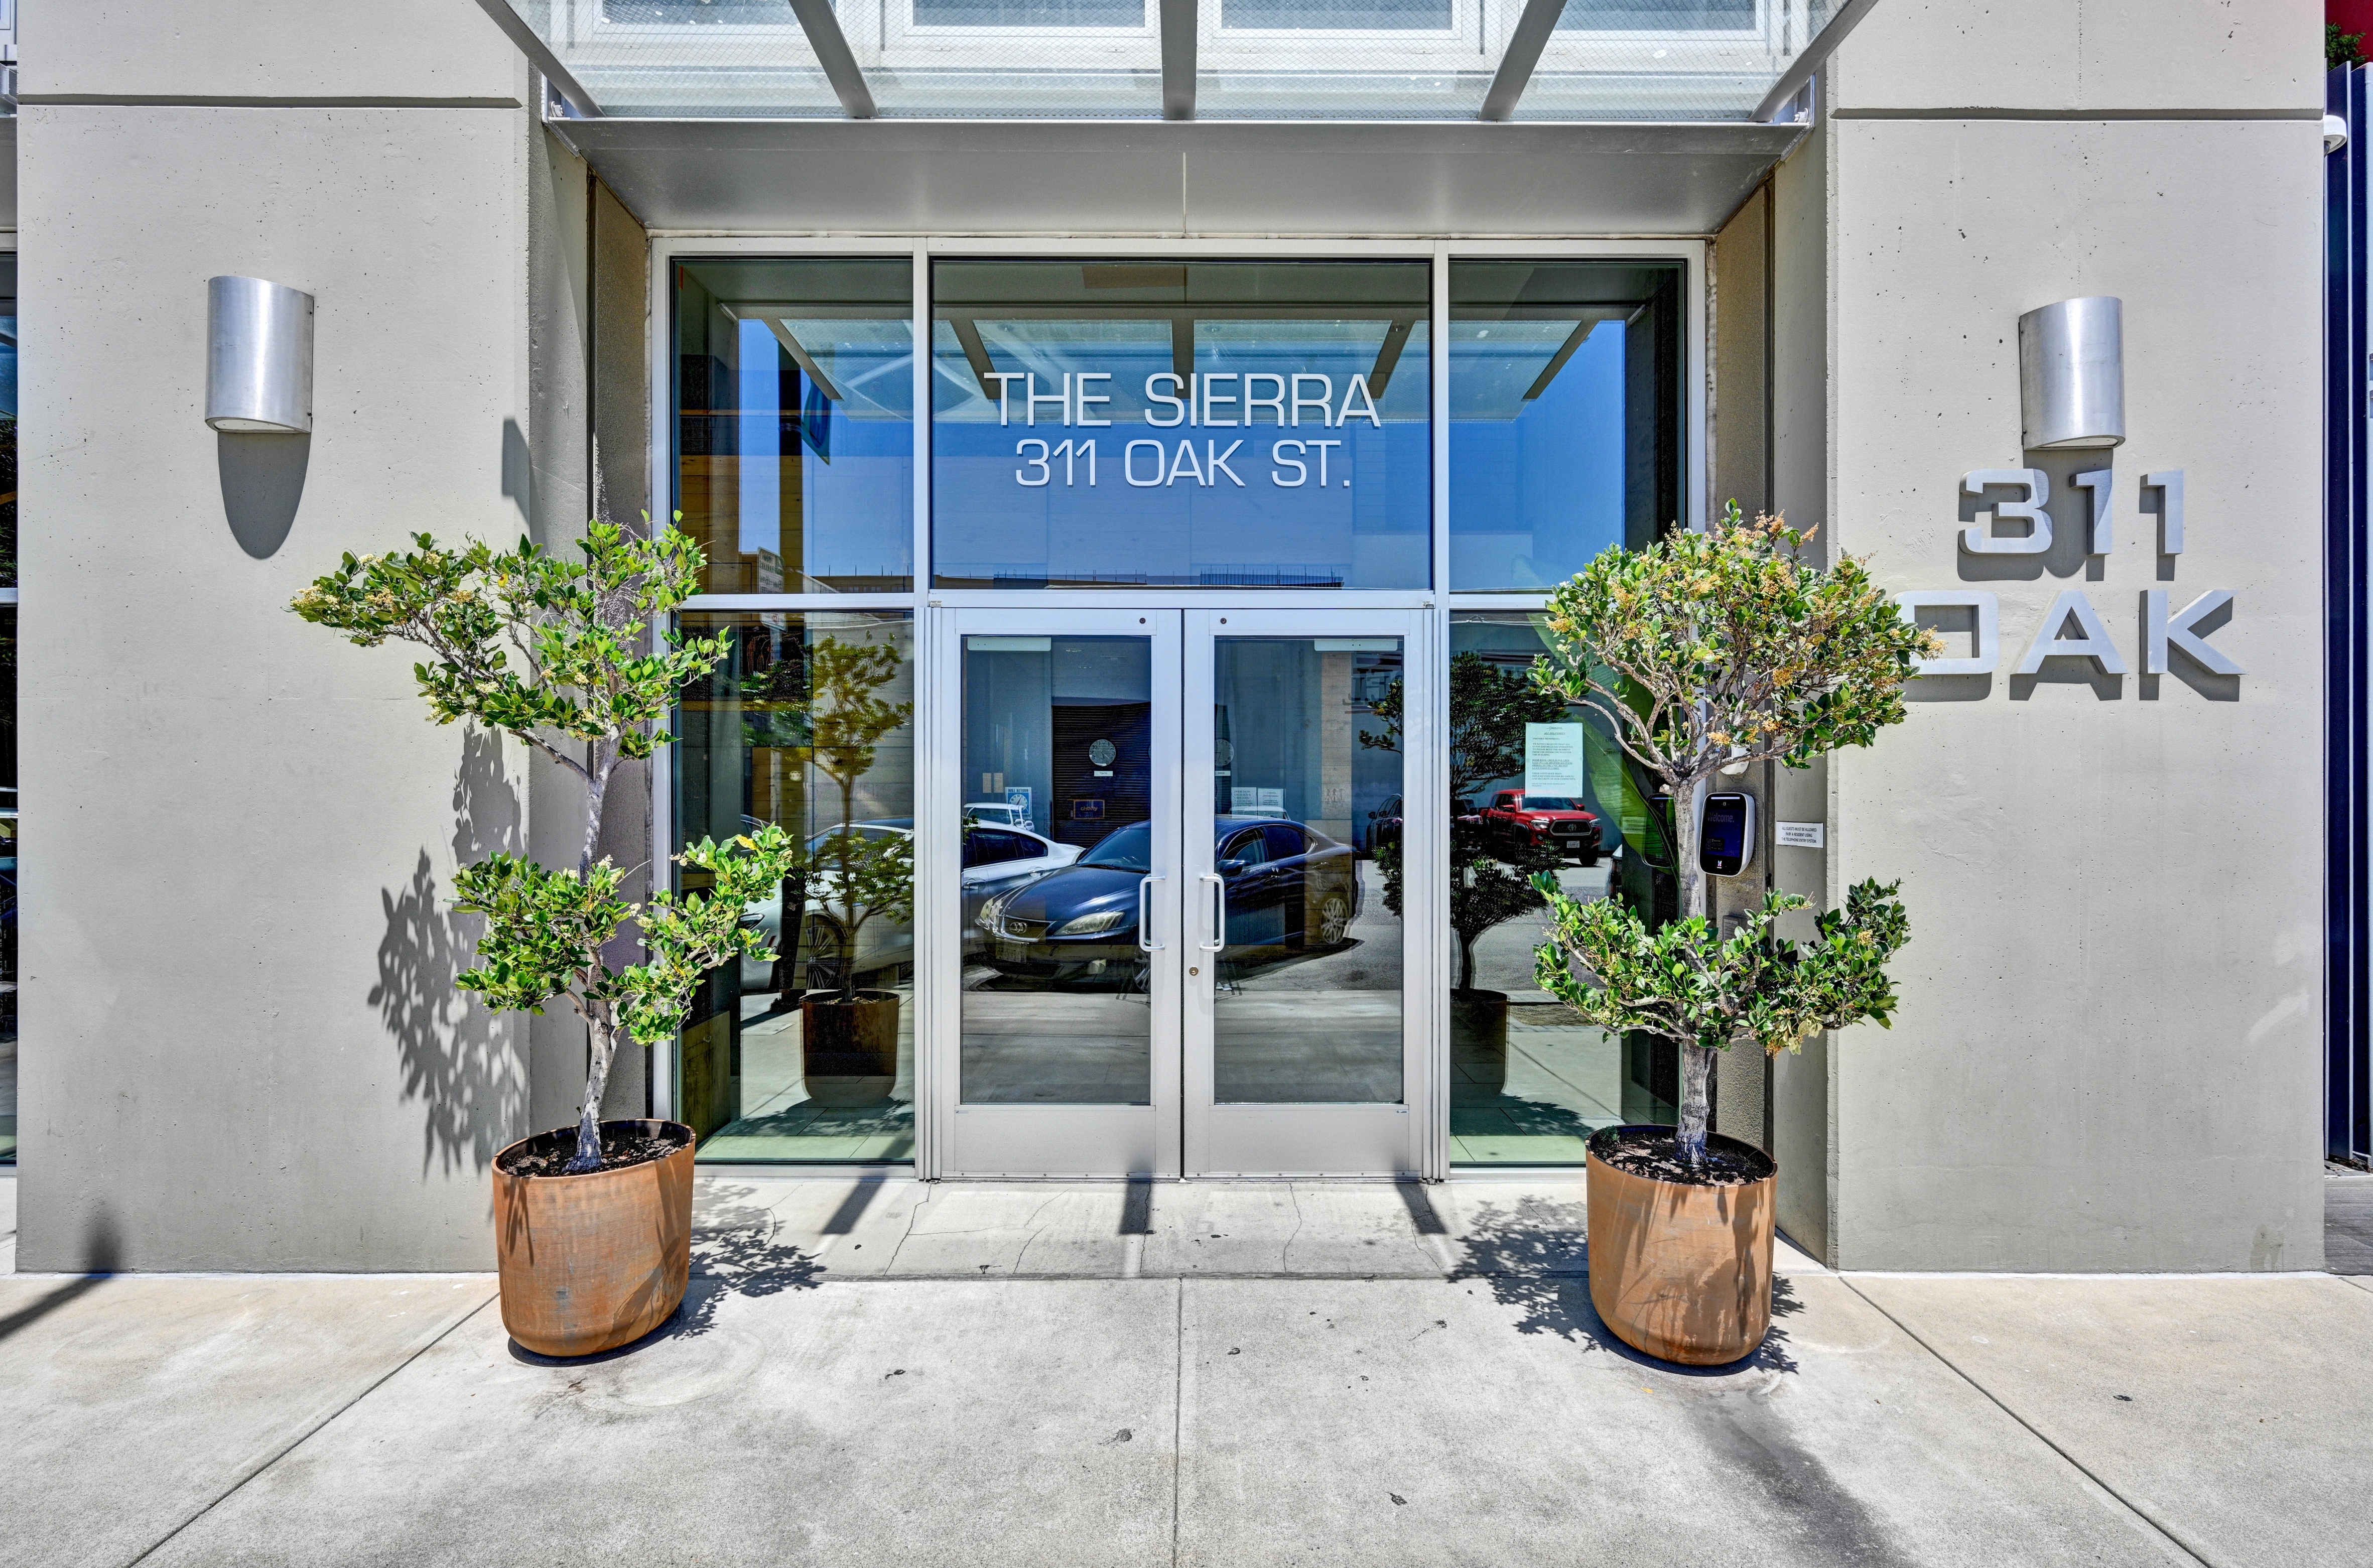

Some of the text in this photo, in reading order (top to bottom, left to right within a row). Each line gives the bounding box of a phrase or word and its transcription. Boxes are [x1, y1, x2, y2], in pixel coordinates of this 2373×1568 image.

[984, 372, 1381, 427] THE SIERRA
[1016, 439, 1350, 486] 311 OAK ST.
[1958, 468, 2184, 555] 311
[1892, 589, 2247, 675] OAK
[1707, 812, 1734, 823] Welcome.
